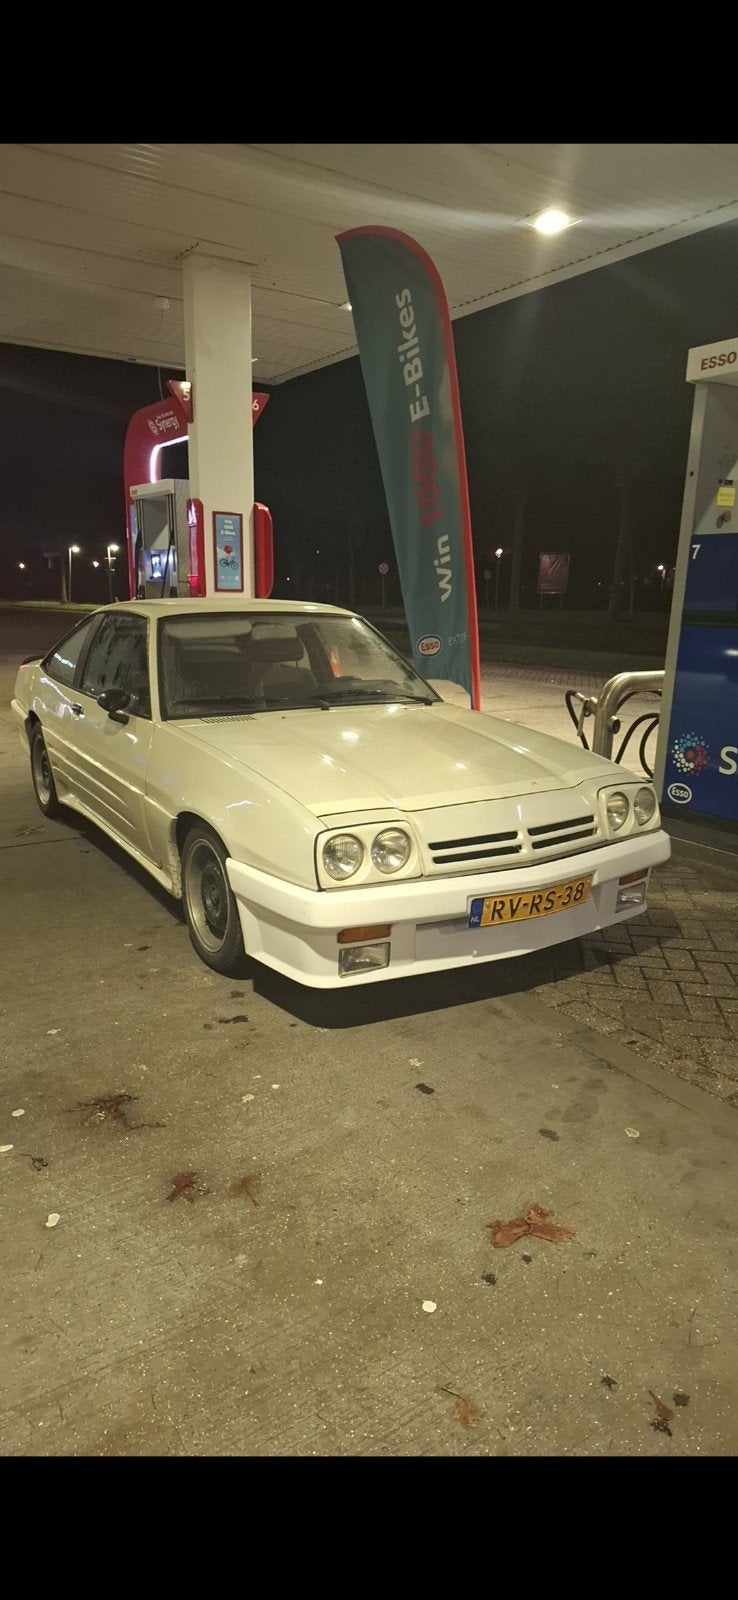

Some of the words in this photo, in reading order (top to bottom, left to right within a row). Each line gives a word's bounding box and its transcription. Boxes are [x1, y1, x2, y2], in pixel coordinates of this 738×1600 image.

[395, 288, 430, 422] E-Bikes
[700, 351, 737, 371] ESSO
[182, 387, 190, 401] 5
[252, 399, 260, 411] 6
[410, 430, 445, 529] 1000
[692, 544, 701, 560] 7
[434, 534, 453, 602] Win
[420, 641, 440, 651] Esso
[671, 786, 689, 798] Esso
[490, 881, 585, 921] RV-RS-38
[470, 915, 480, 923] NL
